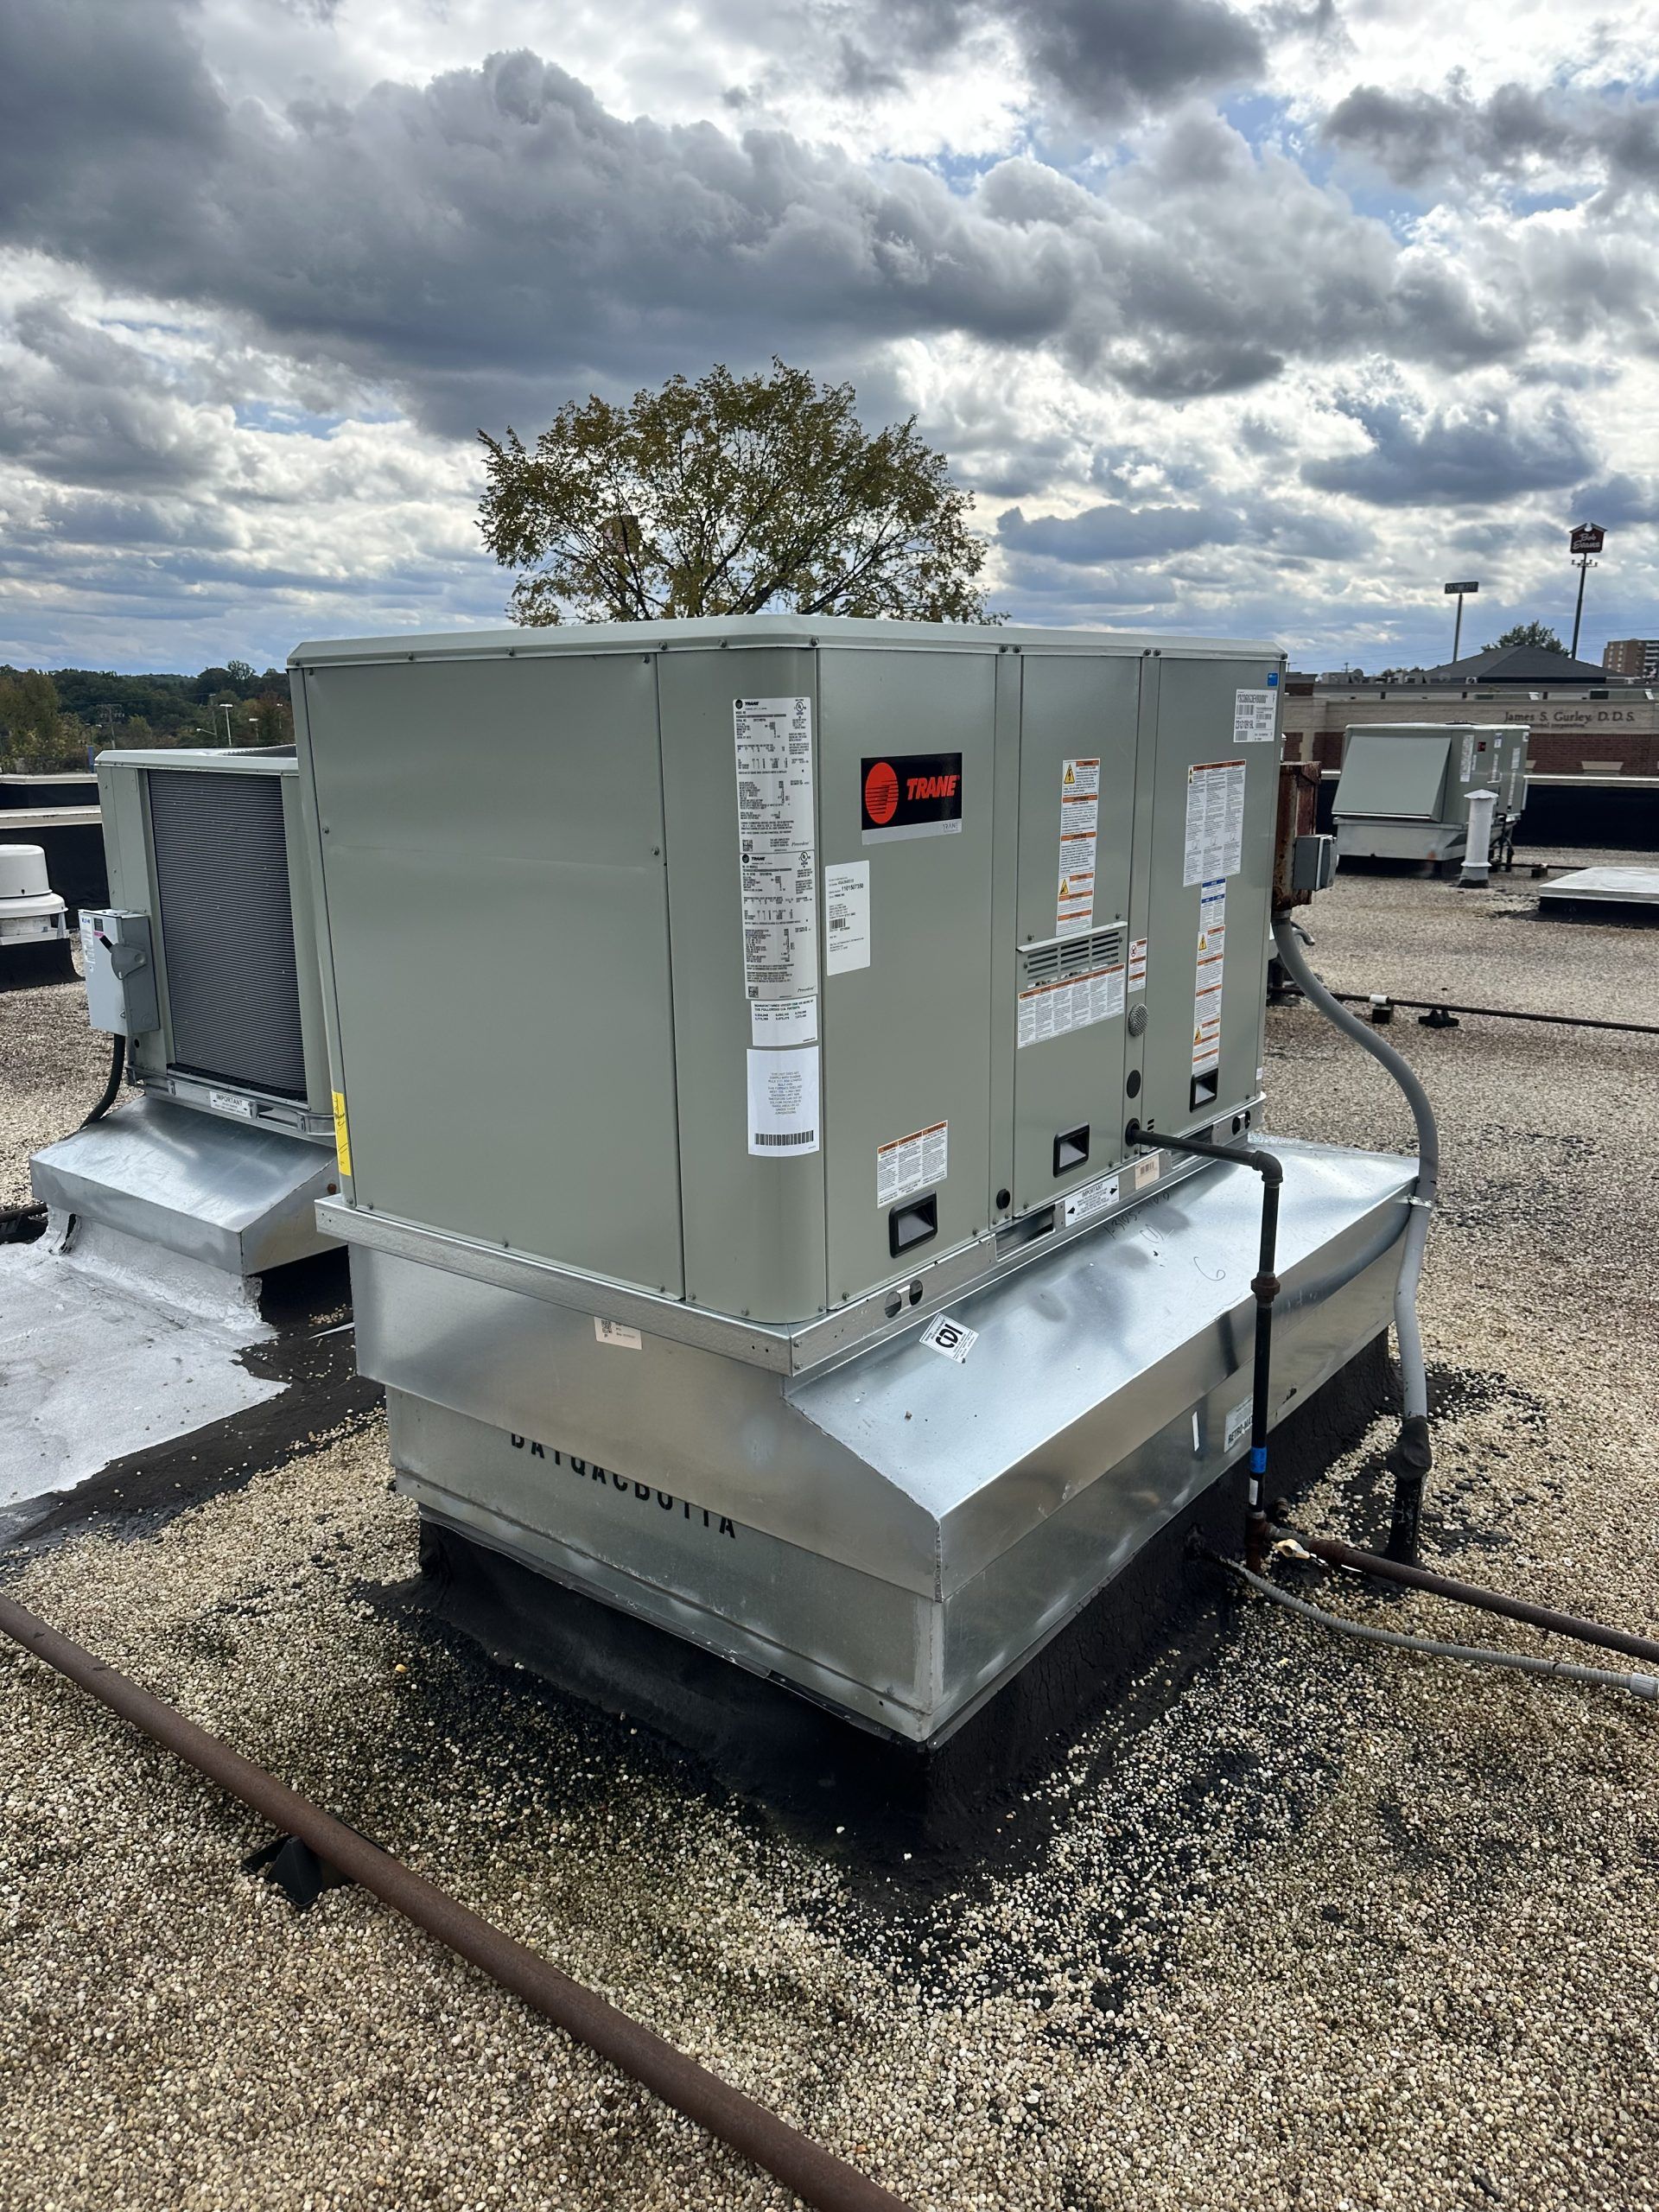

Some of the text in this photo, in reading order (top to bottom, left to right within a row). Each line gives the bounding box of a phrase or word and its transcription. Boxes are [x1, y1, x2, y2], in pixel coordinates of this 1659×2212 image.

[1503, 711, 1535, 723] James
[906, 775, 957, 800] TRANE
[935, 1323, 963, 1349] CDI
